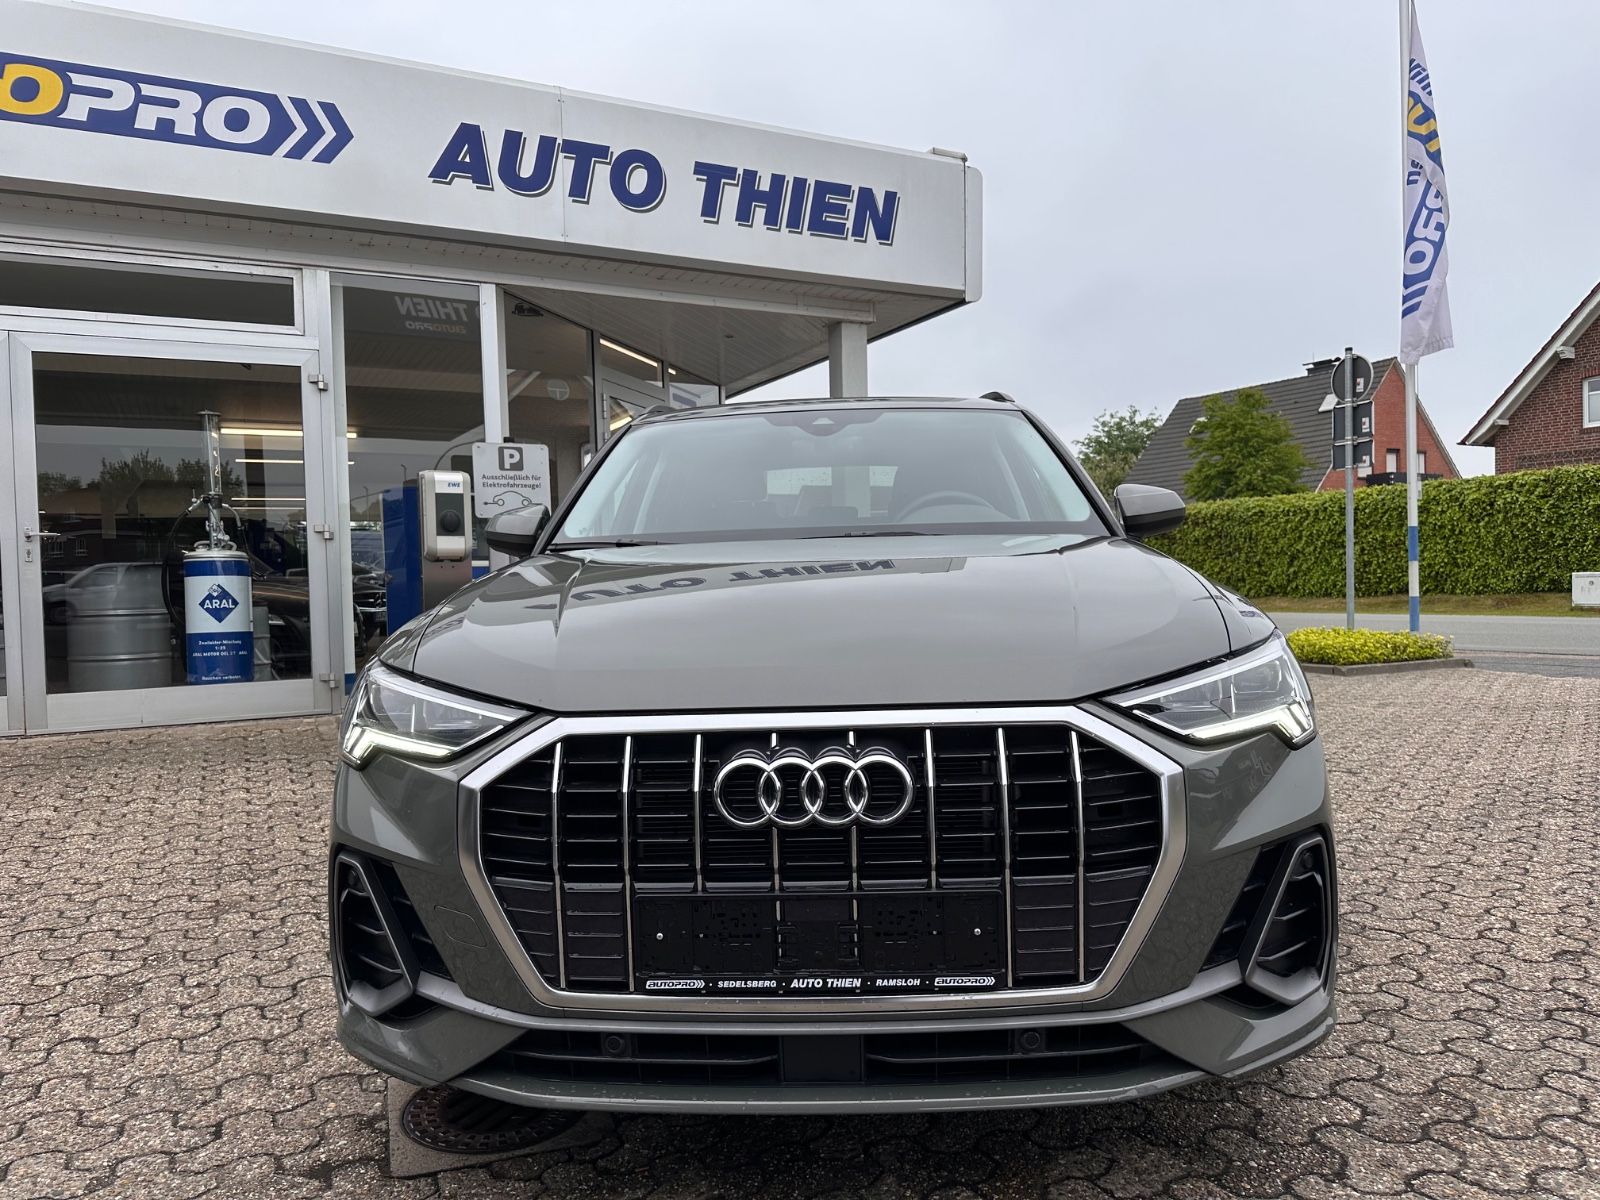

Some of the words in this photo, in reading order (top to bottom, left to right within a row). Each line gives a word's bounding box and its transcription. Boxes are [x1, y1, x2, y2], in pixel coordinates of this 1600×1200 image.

[428, 122, 666, 212] AUTO
[693, 161, 900, 246] THIEN
[503, 448, 520, 470] P
[531, 473, 541, 481] für
[203, 599, 235, 609] ARAL
[717, 980, 777, 988] SEDELSBERG
[790, 978, 822, 988] AUTO
[826, 978, 861, 988] THIEN
[875, 978, 921, 987] RAMSLOH
